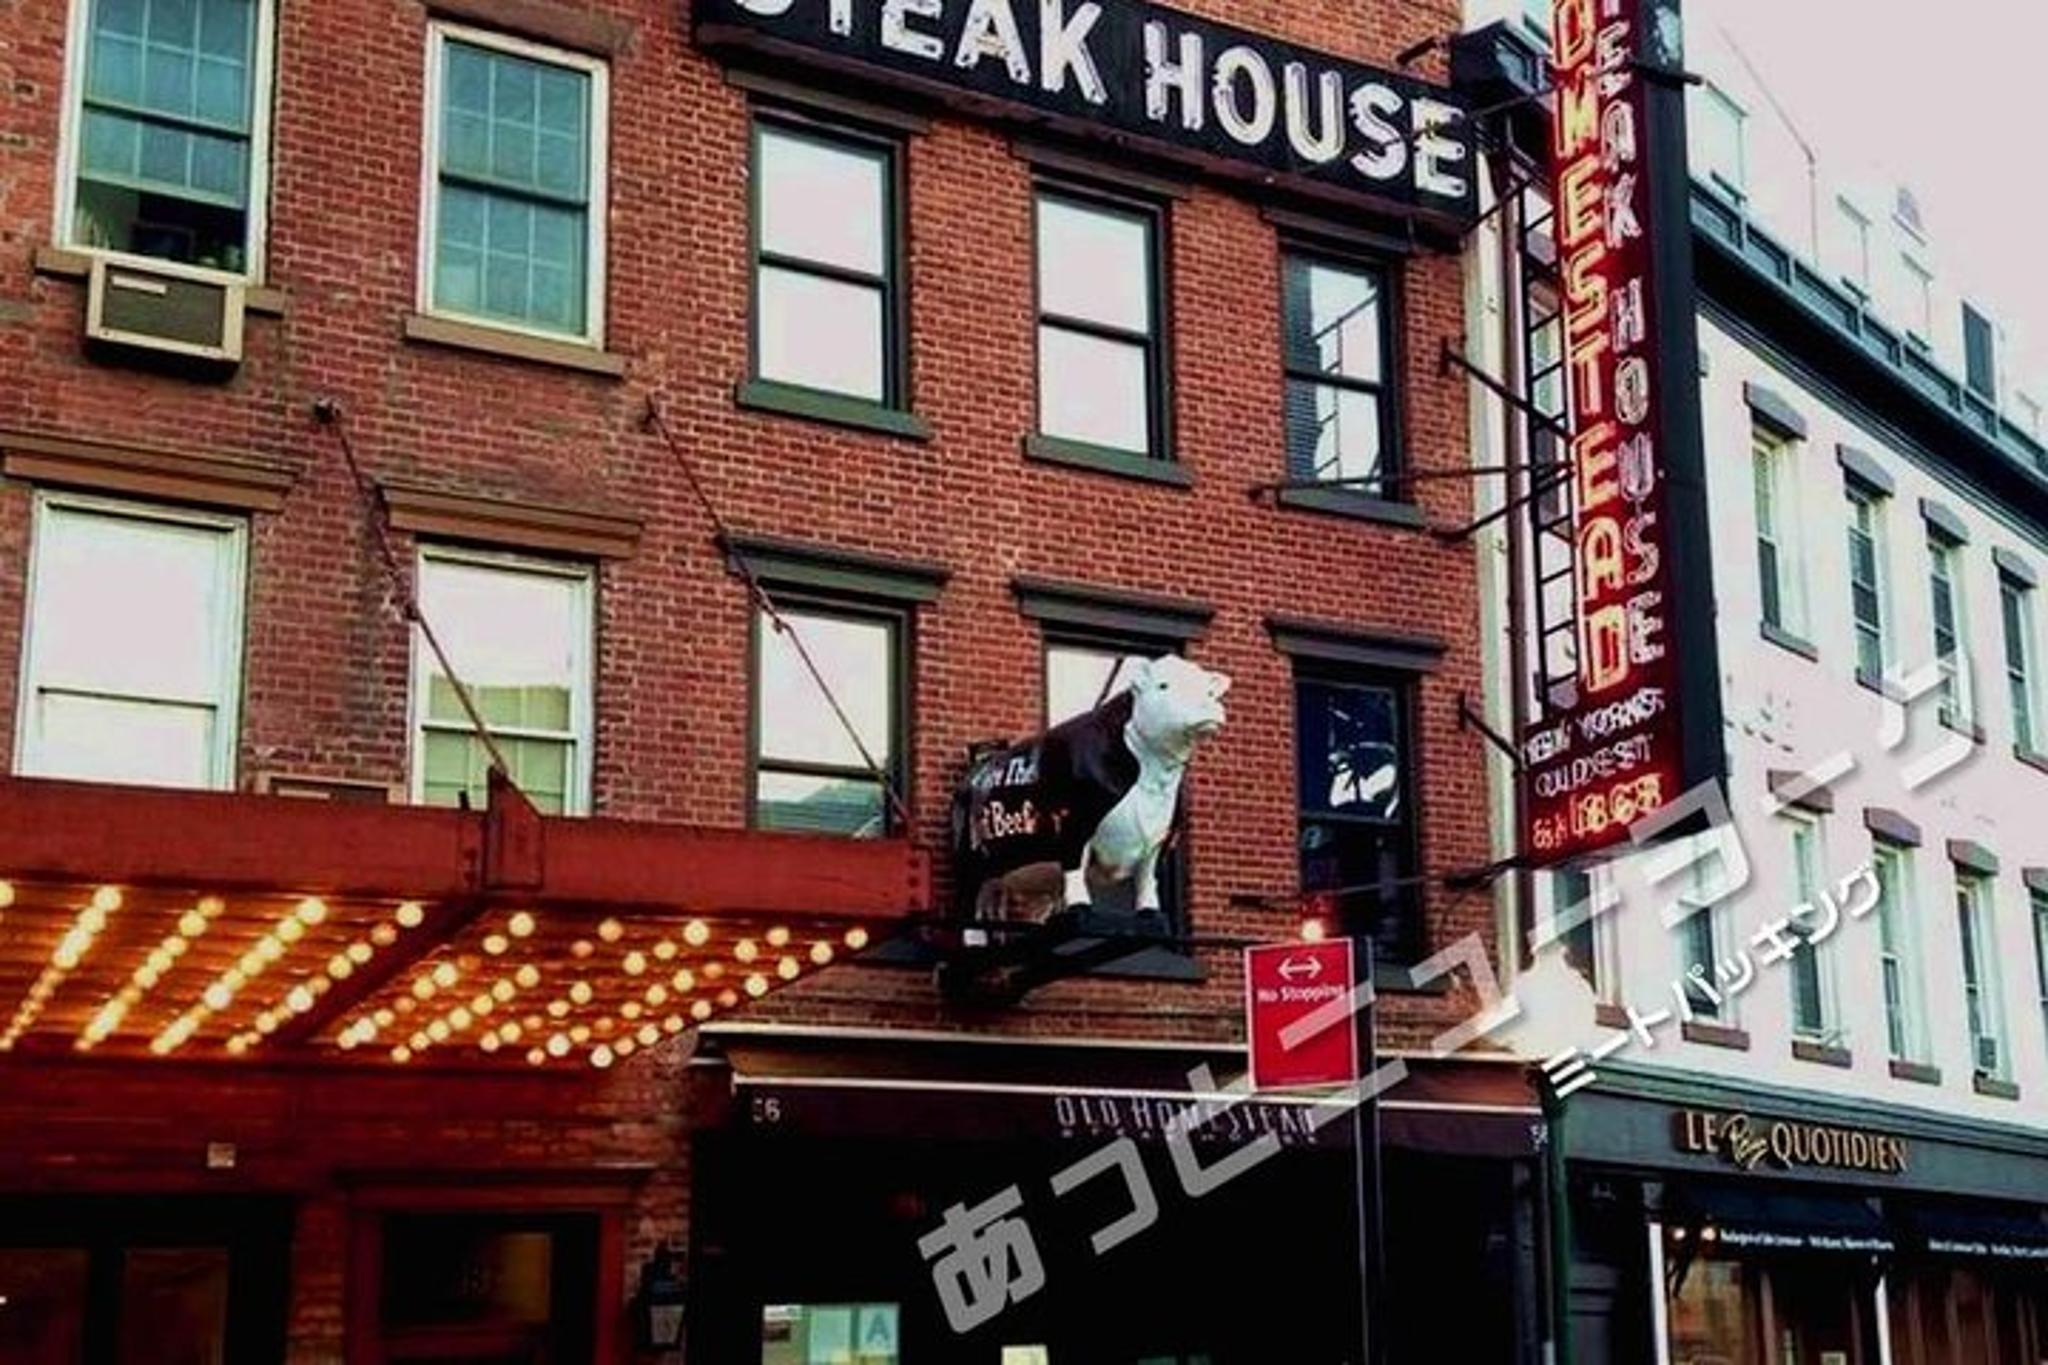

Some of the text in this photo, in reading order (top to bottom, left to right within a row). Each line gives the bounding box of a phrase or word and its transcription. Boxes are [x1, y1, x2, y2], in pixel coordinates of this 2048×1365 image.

[1141, 21, 1468, 198] HOUSE
[1597, 0, 1665, 665] EAK HOUSE
[1685, 1110, 1719, 1151] LE
[1770, 1122, 1908, 1173] QUOTIDIEN
